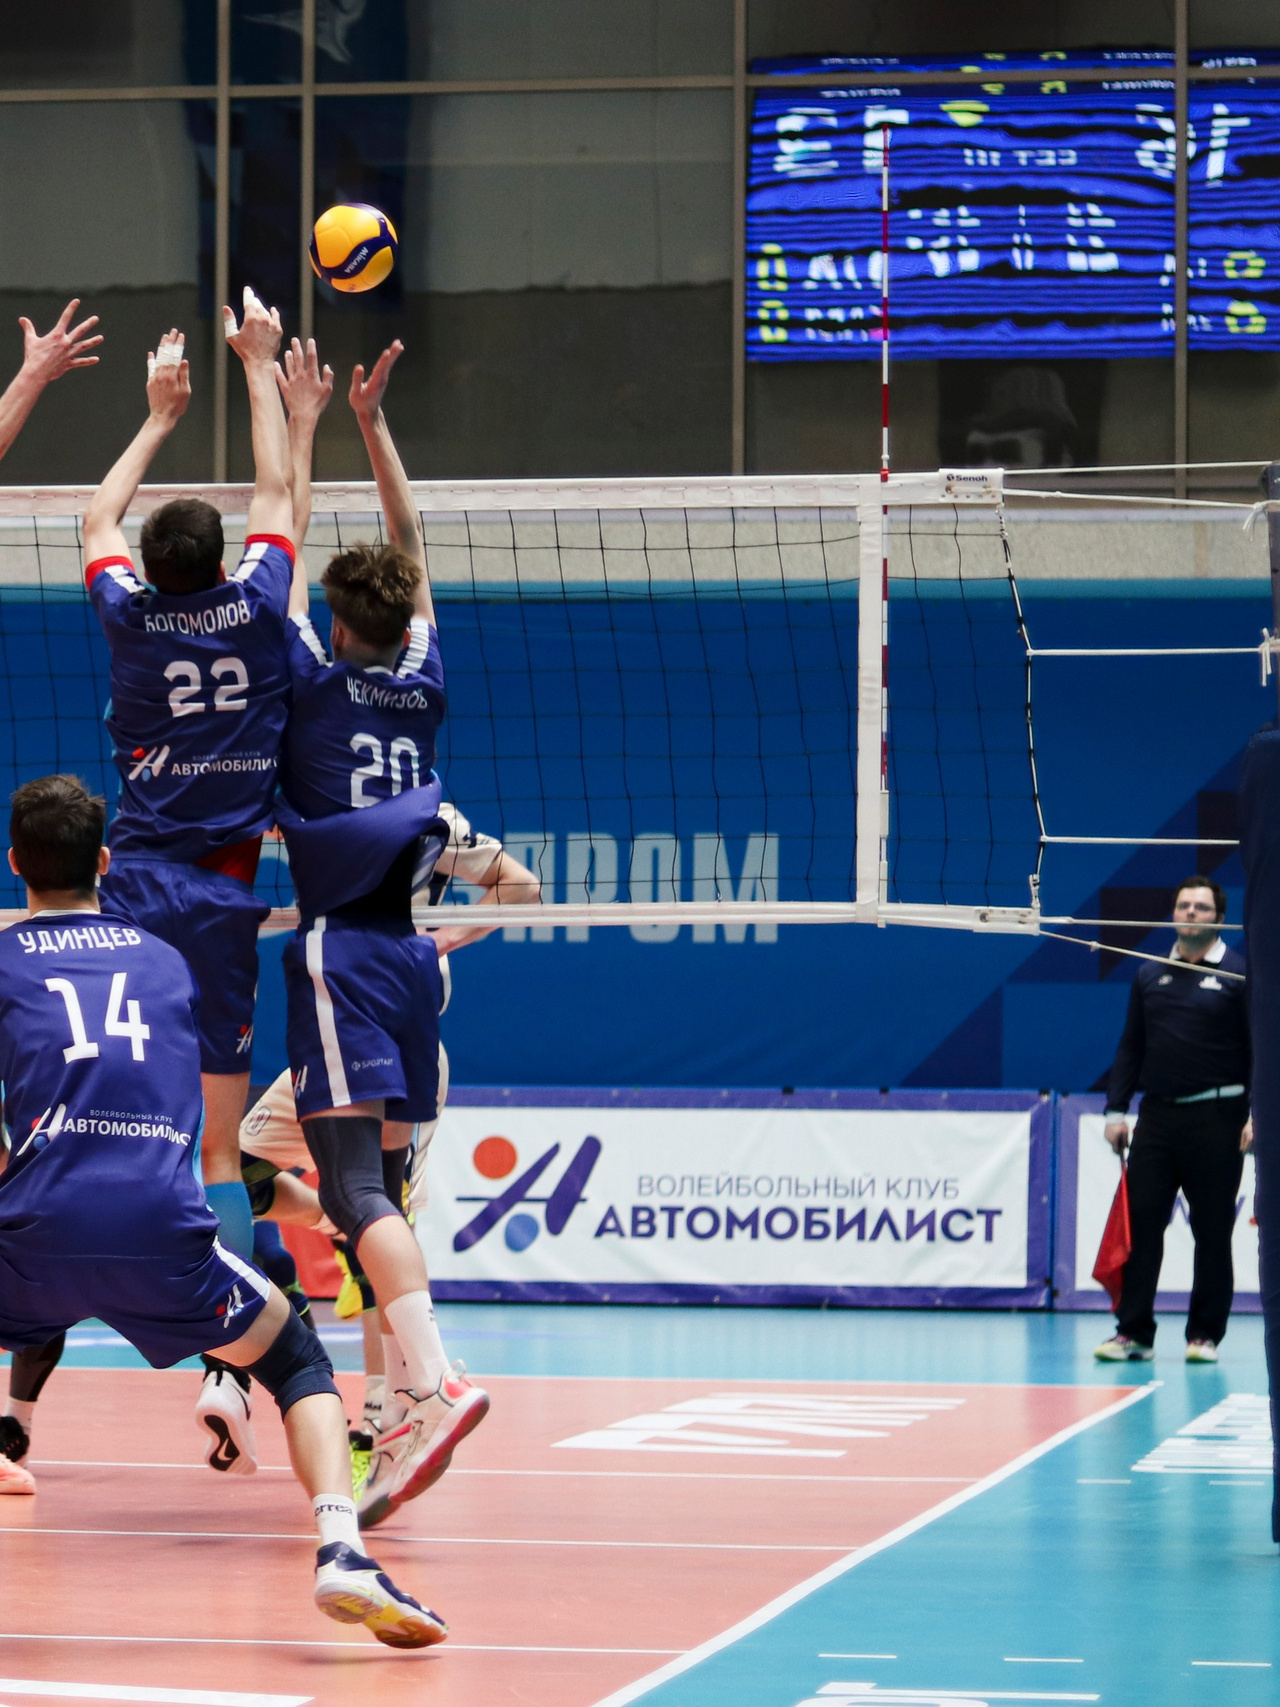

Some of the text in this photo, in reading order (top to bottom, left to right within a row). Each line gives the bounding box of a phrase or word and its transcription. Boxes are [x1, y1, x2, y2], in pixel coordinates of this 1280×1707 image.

[145, 600, 251, 636] БОГОМОЛОВ
[163, 657, 250, 718] 22
[171, 757, 278, 776] АВТОМОБИЛИ
[349, 733, 420, 808] 20
[17, 926, 141, 954] УДИНЦЕВ
[45, 972, 150, 1065] 14
[637, 1174, 960, 1200] ВОЛЕЙБОЛЬНЫЙ КЛУБ
[594, 1206, 1003, 1244] АВТОМОБИЛИСТ
